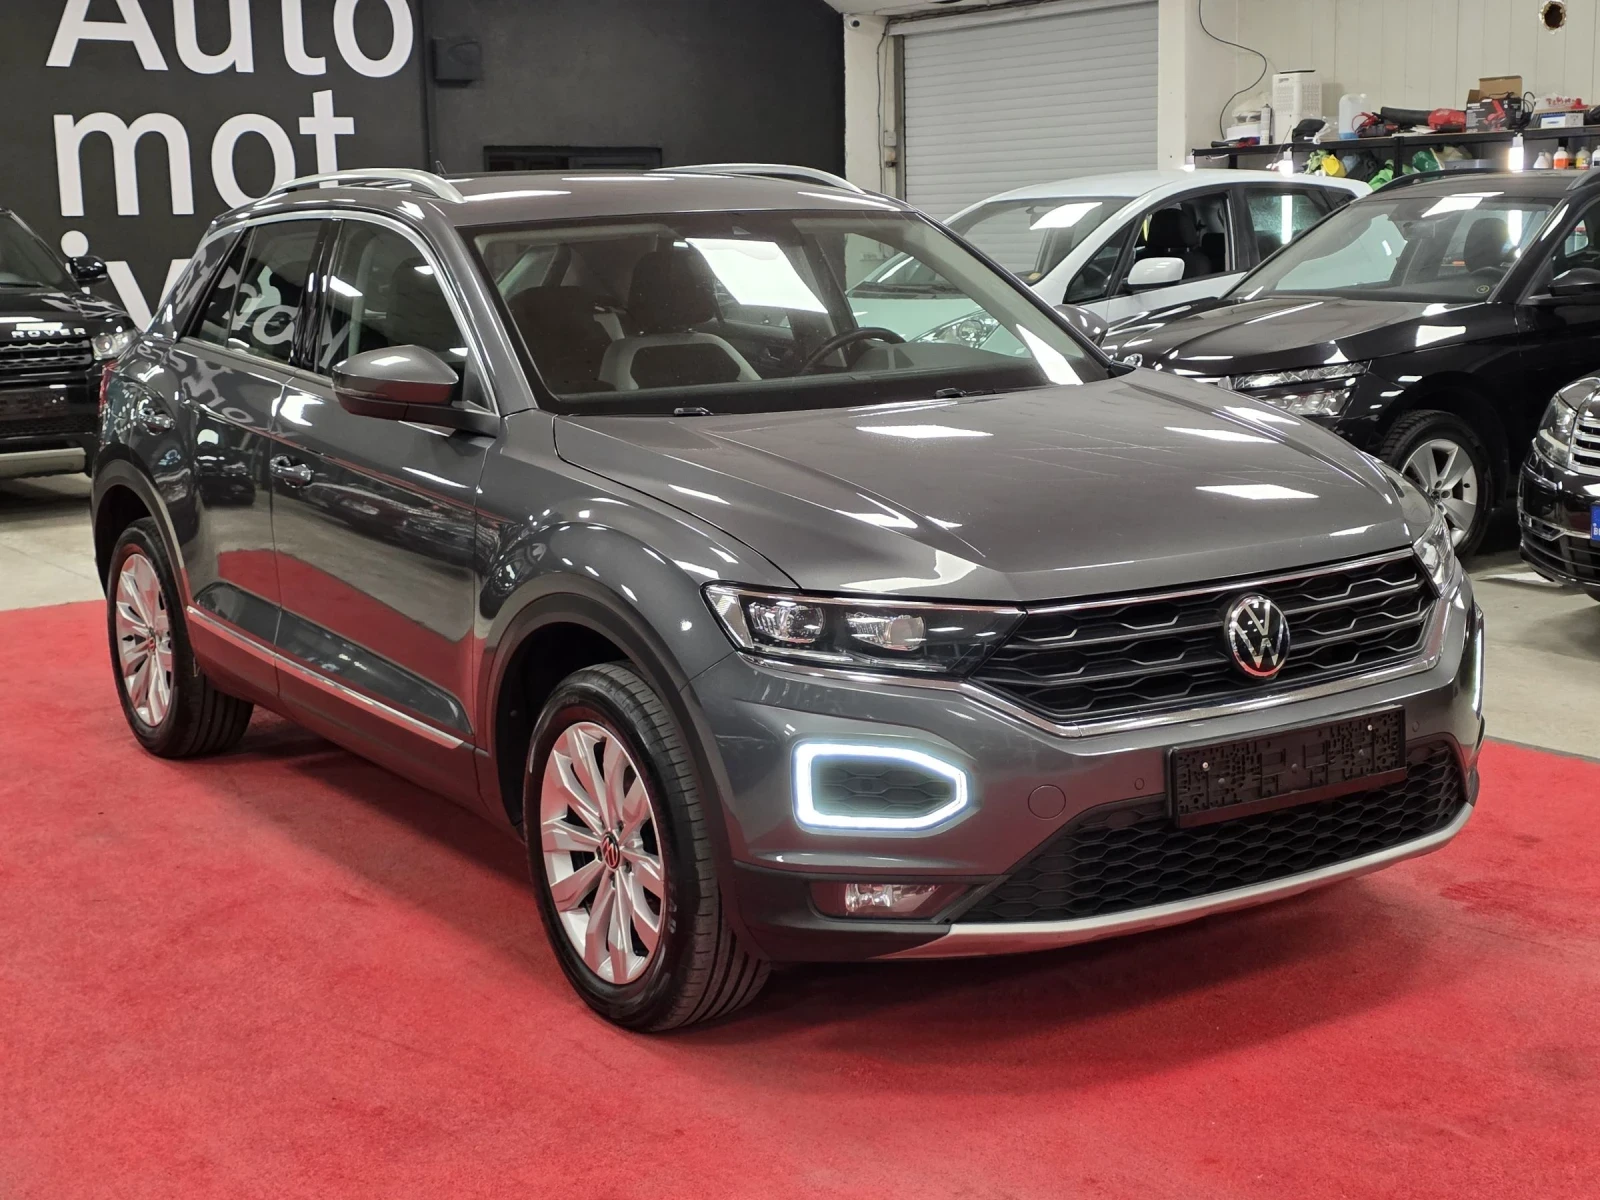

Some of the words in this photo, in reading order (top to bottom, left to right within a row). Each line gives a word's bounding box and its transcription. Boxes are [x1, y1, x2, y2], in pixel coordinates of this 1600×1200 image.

[53, 90, 355, 217] mot
[11, 327, 87, 338] ROVER
[61, 230, 193, 333] v
